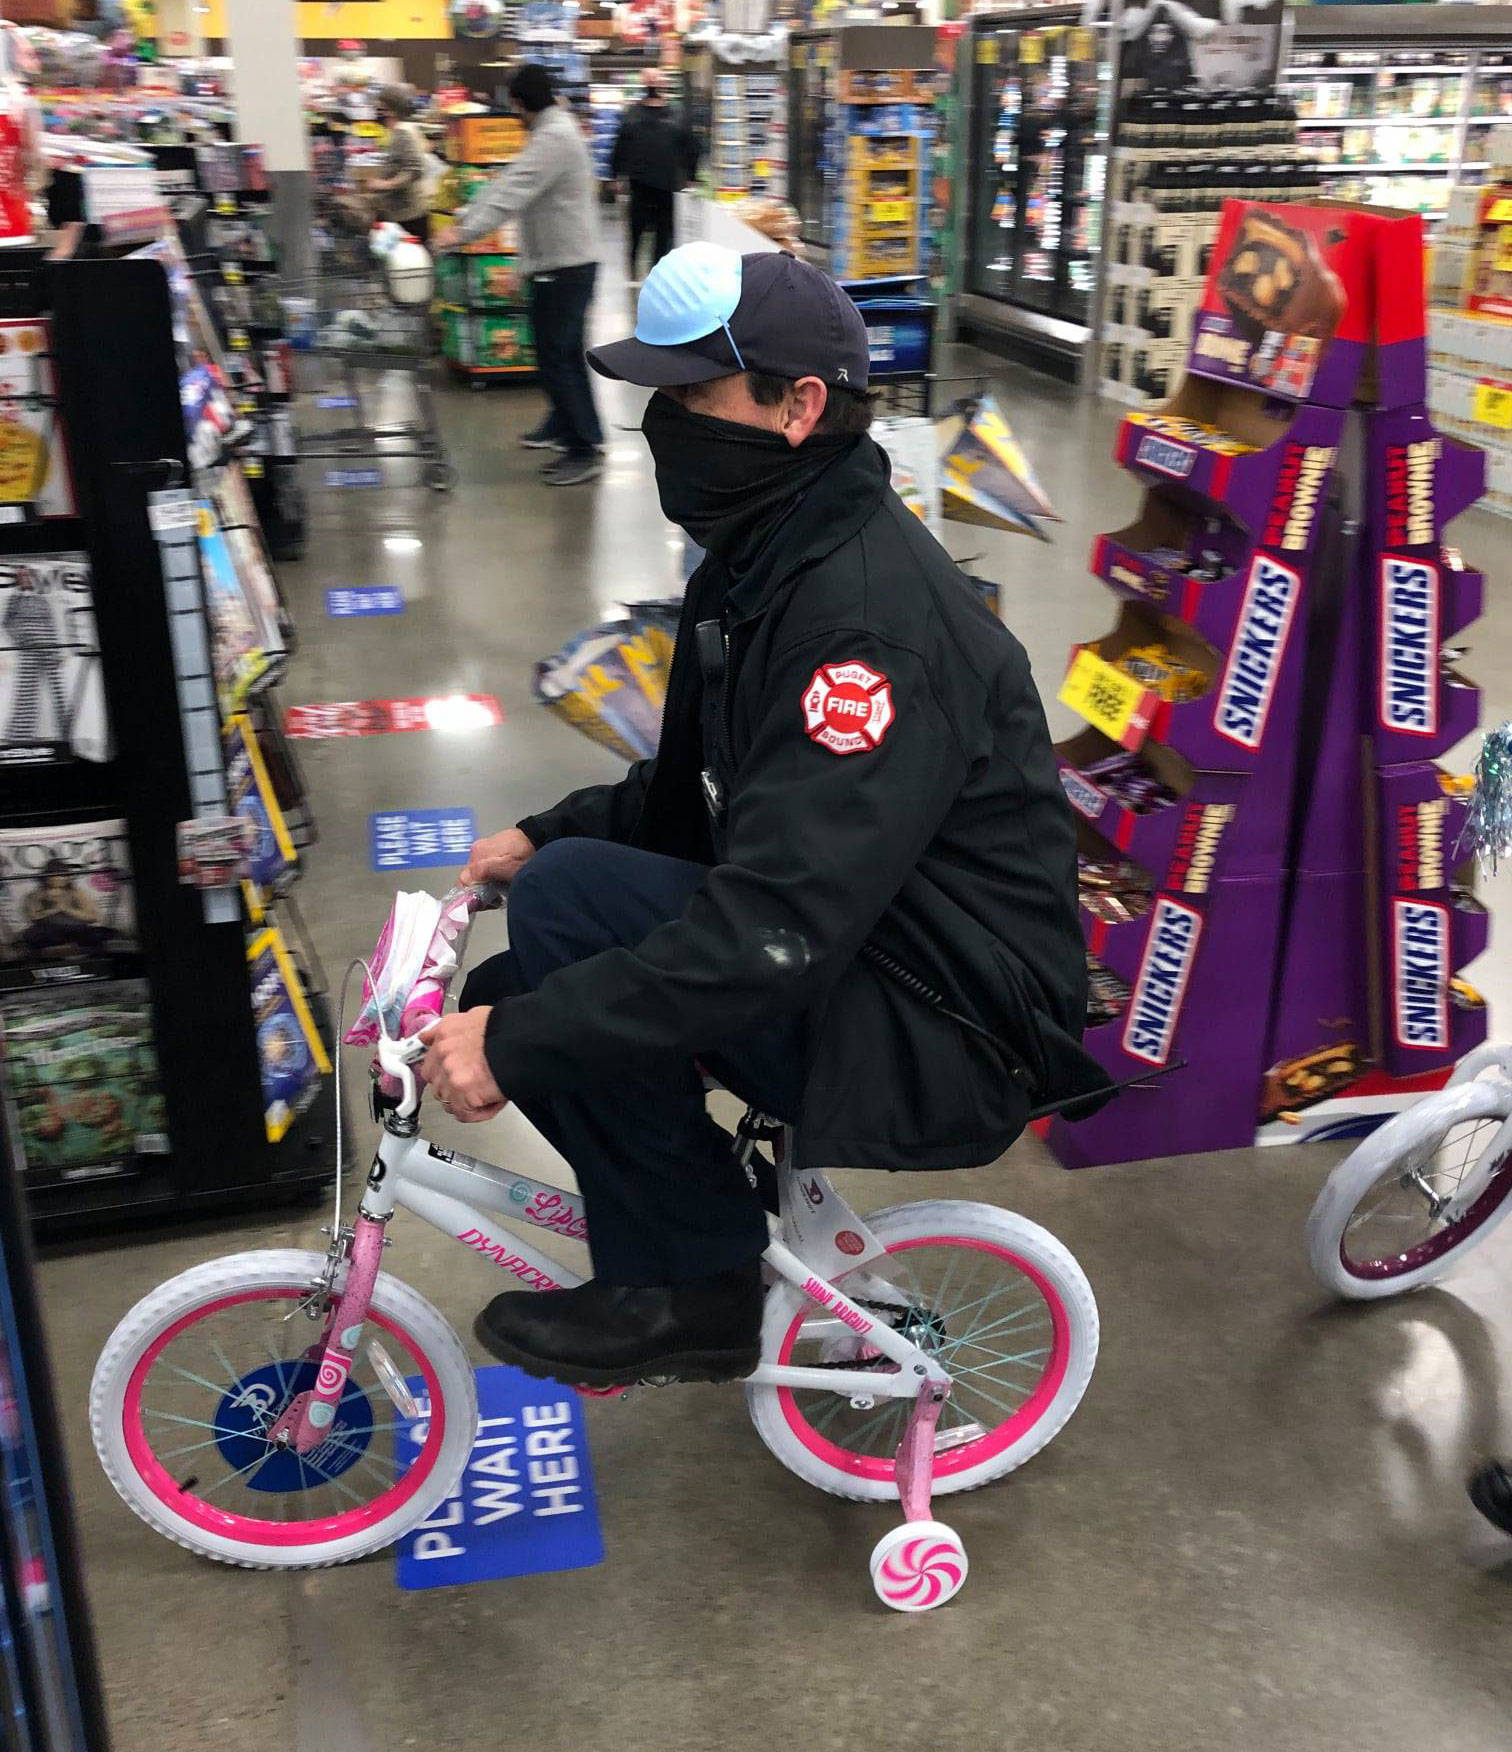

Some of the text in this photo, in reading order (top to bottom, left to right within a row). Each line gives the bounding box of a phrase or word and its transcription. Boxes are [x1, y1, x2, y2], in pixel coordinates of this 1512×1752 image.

[1280, 446, 1329, 551] BROWNIE
[1406, 440, 1436, 545] BROWNIE
[1224, 564, 1291, 738] SNICKERS
[1391, 564, 1428, 727] SNICKERS
[826, 695, 870, 718] FIRE
[376, 815, 411, 866] PLEASE
[407, 821, 441, 856] WAIT
[439, 818, 473, 854] HERE
[1131, 906, 1194, 1058] SNICKERS
[1405, 905, 1440, 1043] SNICKERS
[468, 1414, 525, 1527] WAIT
[522, 1401, 585, 1518] HERE
